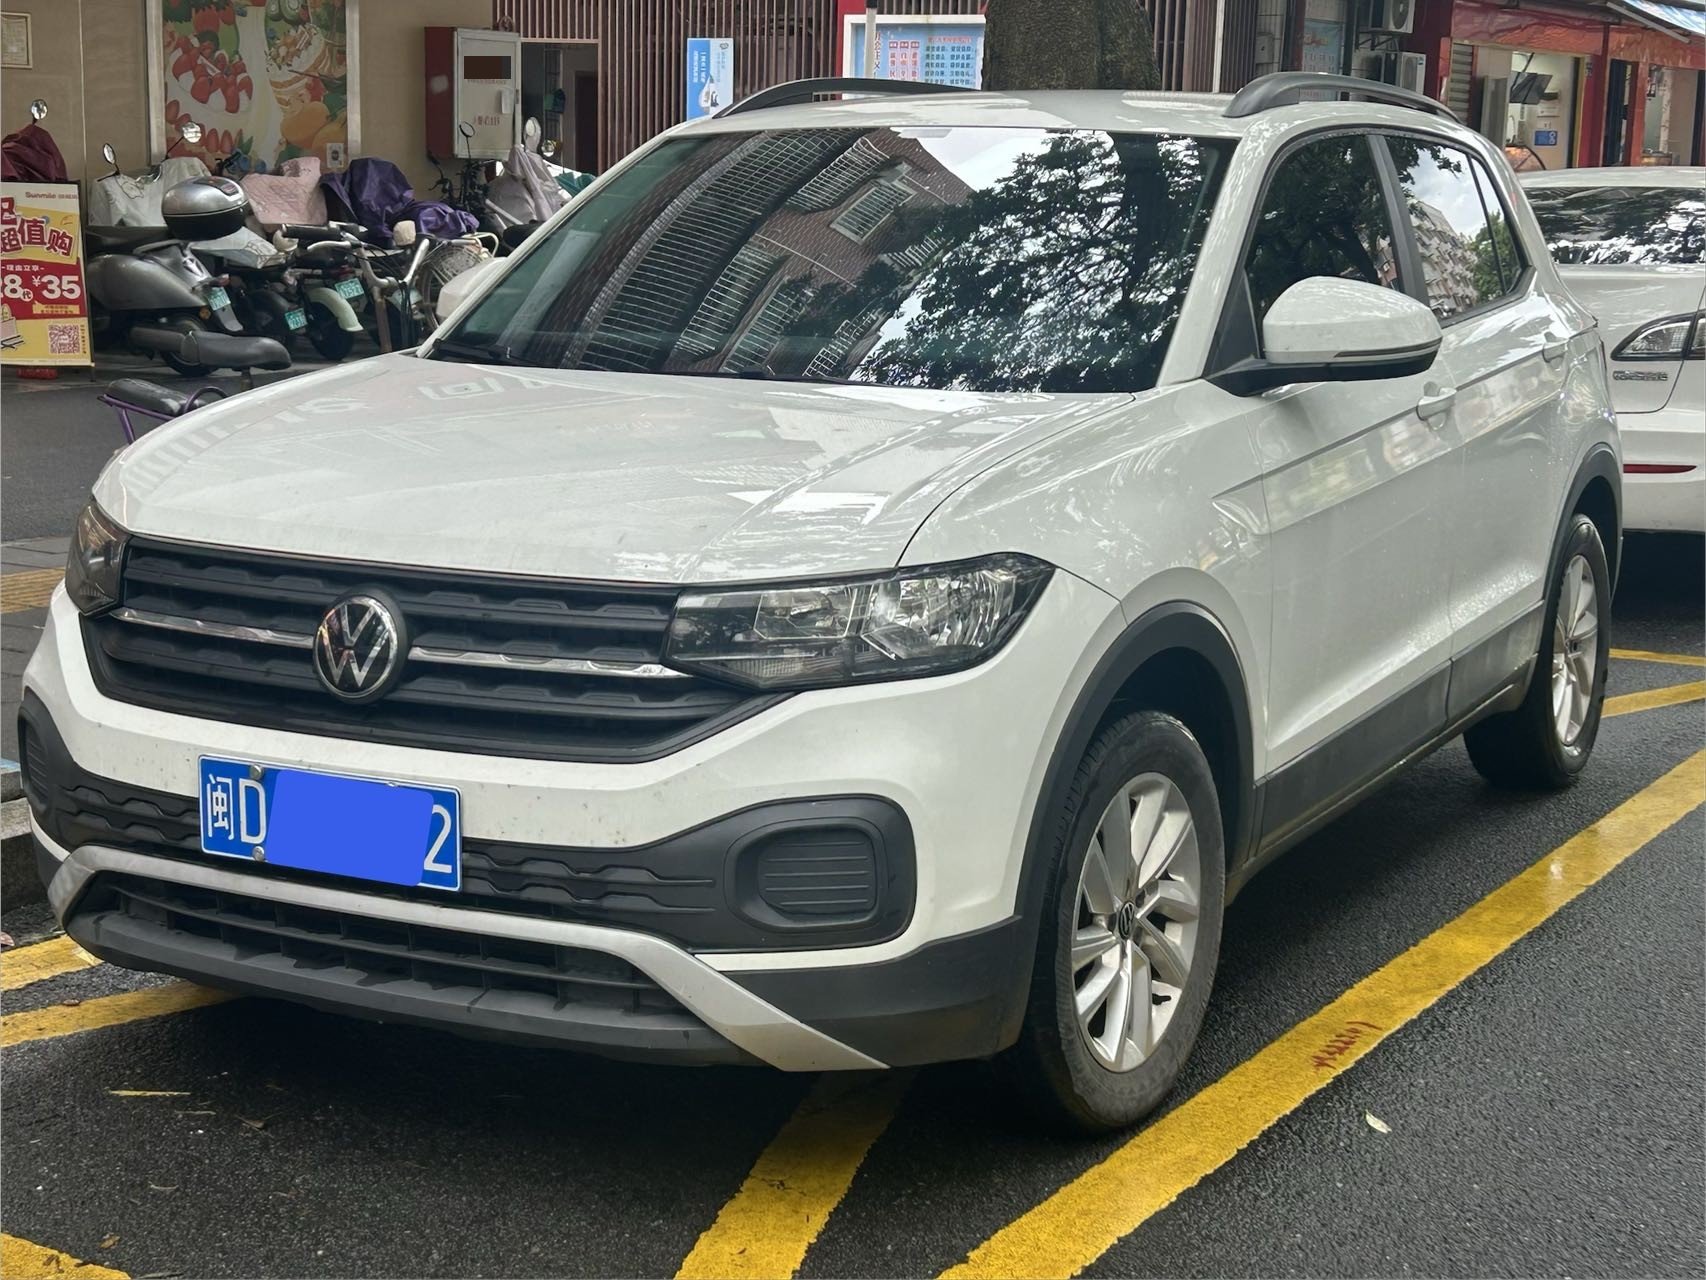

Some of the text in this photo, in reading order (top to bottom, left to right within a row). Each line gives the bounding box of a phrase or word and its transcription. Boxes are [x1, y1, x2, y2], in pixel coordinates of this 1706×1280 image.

[25, 191, 56, 199] Sunmile
[32, 275, 81, 299] ¥35
[205, 773, 267, 845] 闽D
